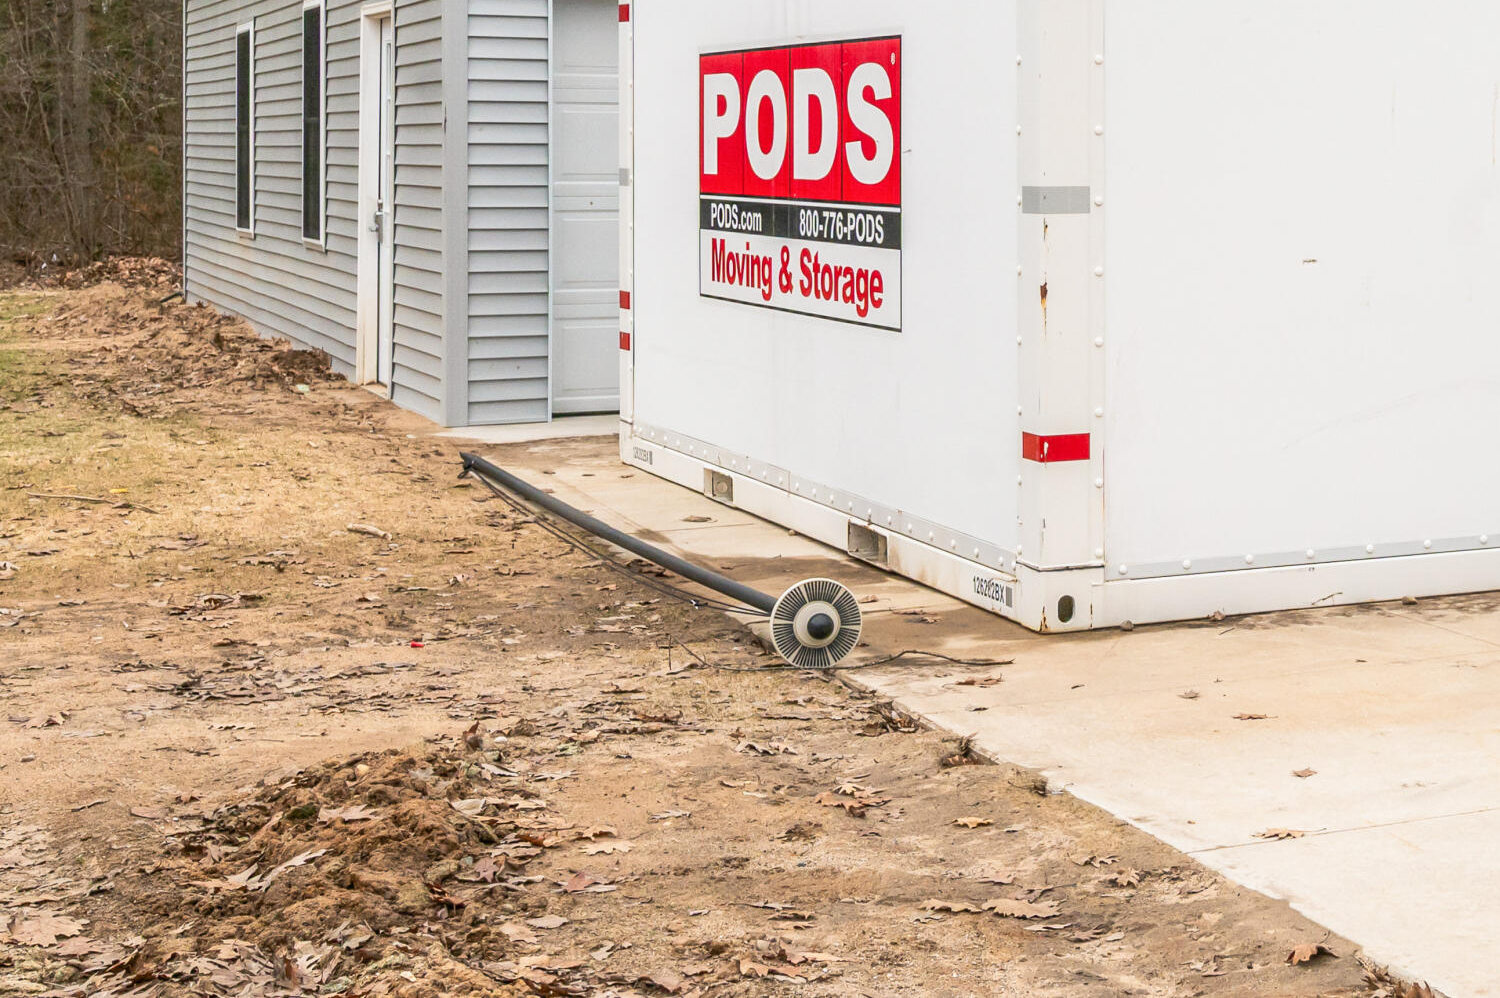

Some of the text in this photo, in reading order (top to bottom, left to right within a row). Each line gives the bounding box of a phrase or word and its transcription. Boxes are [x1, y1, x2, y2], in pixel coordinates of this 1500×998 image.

[703, 61, 894, 185] PODS
[710, 202, 885, 245] PODS.com 800-776-PODS
[711, 237, 884, 318] Moving & Storage
